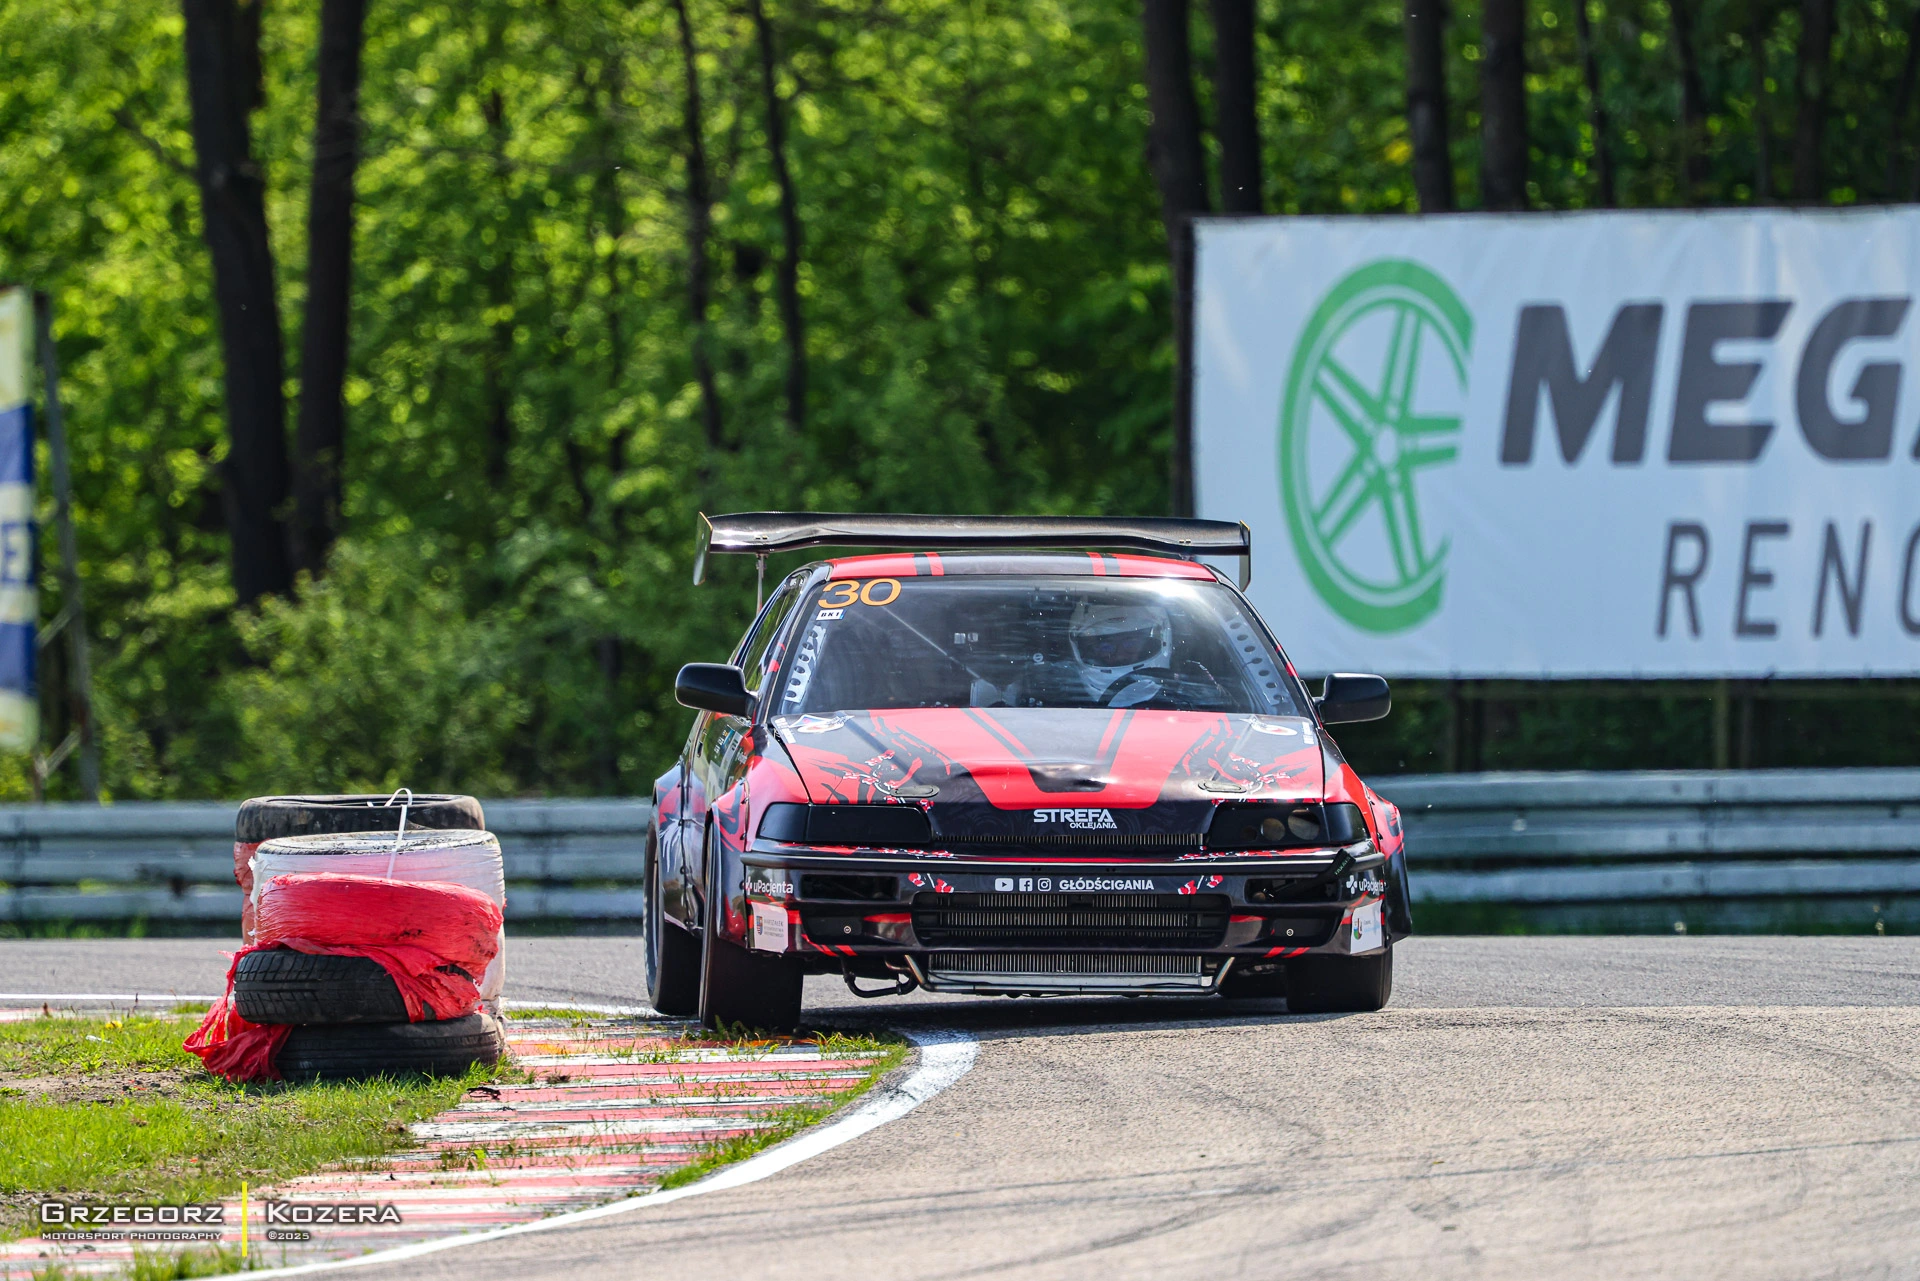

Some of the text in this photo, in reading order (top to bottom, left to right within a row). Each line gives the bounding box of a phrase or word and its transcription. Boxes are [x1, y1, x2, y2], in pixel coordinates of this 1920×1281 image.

[1500, 297, 1920, 465] MEG
[818, 578, 902, 609] 30
[1033, 808, 1114, 823] STREFA
[1069, 822, 1118, 830] OKLEJANIA
[754, 879, 793, 896] uPacjenta
[1059, 877, 1154, 892] GŁÓDŚCIGANIA
